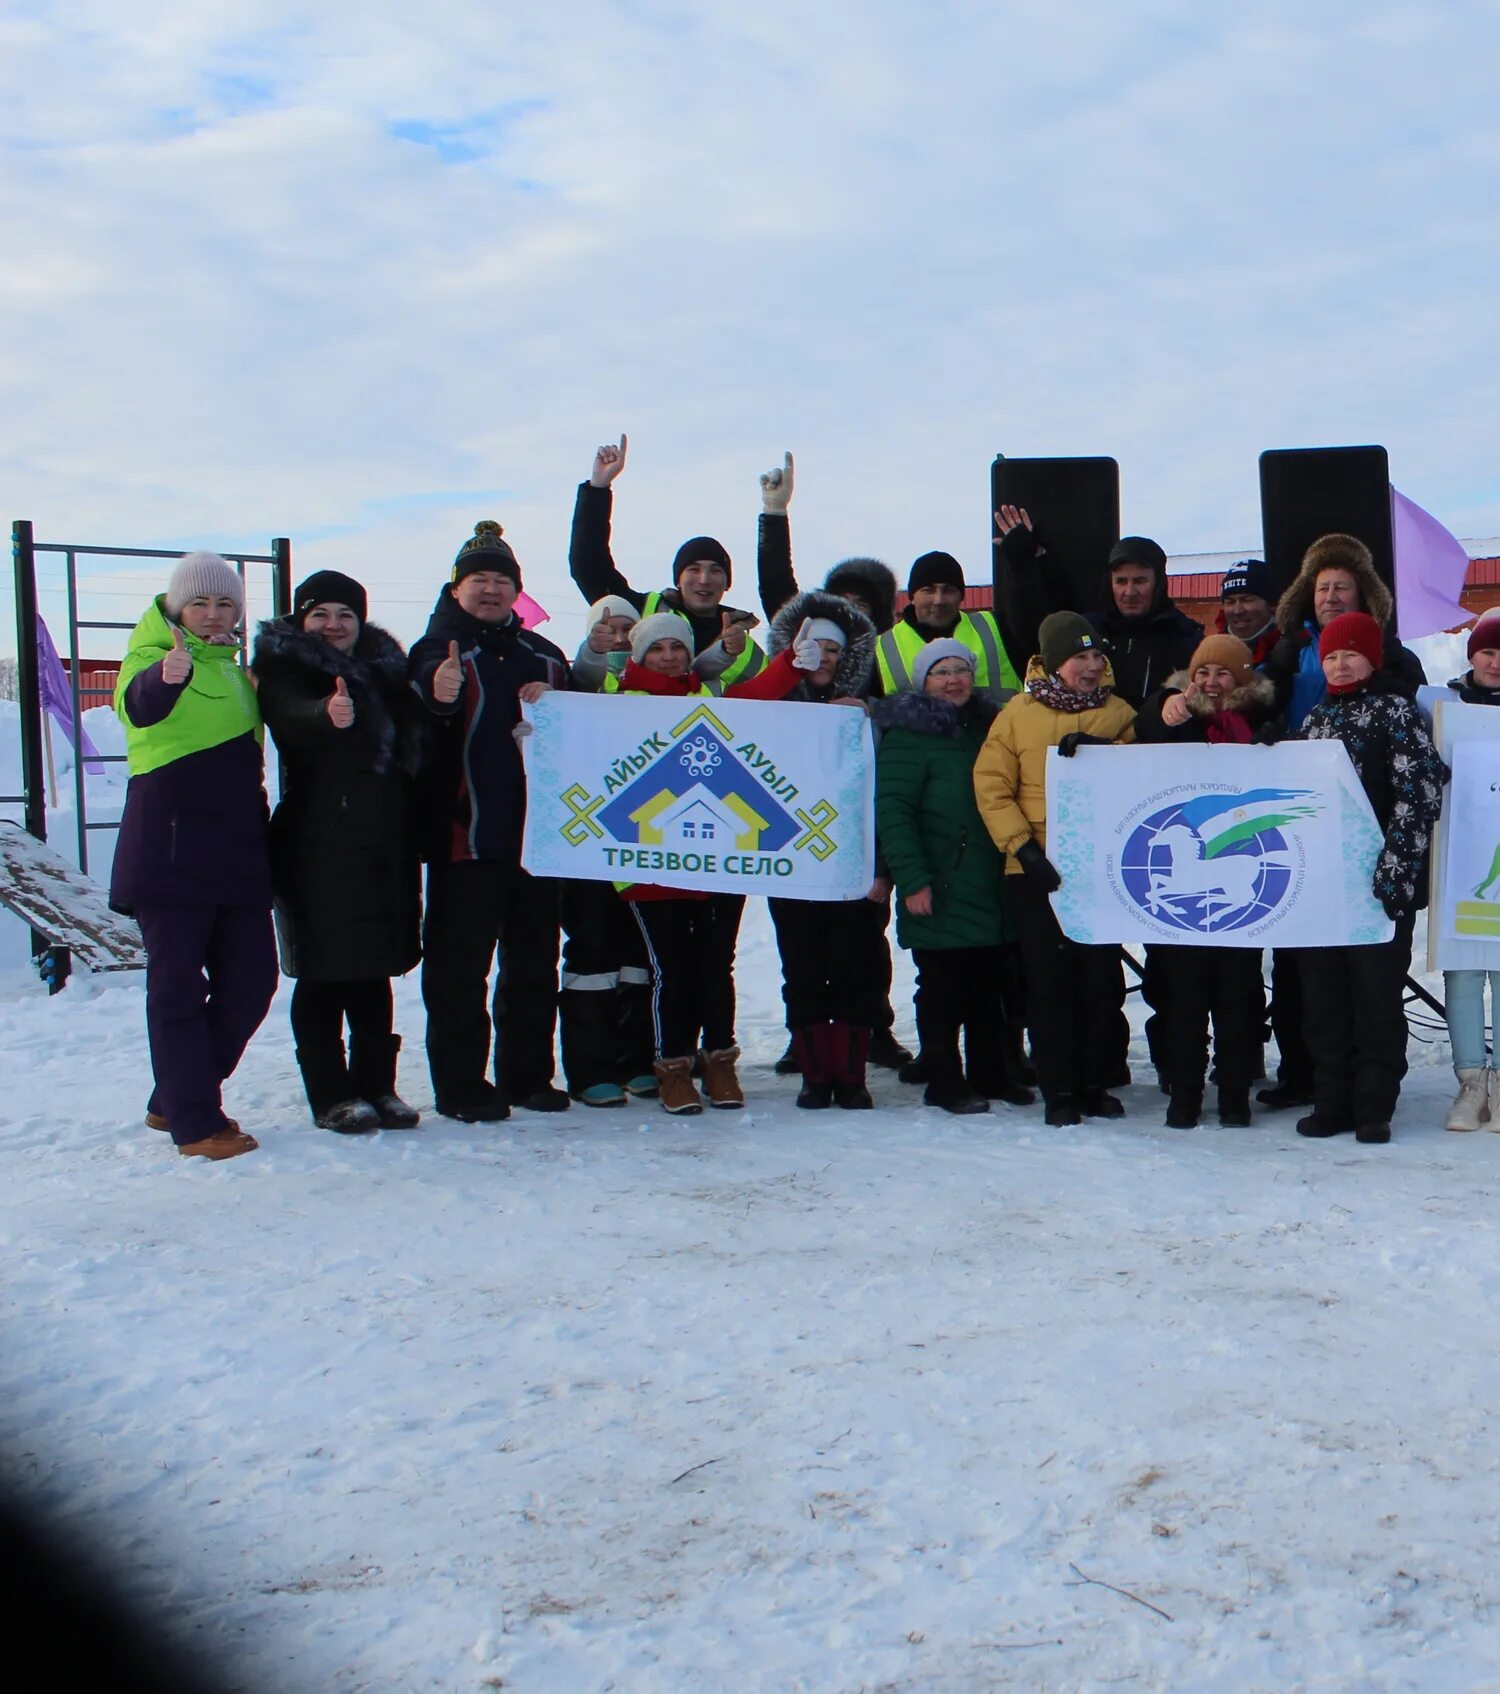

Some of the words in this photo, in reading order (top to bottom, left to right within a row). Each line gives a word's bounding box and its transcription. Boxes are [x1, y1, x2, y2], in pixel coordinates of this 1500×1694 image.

[602, 731, 669, 795] АЙЫҠ
[736, 742, 800, 803] АУЫЛ
[602, 847, 717, 873] ТРЕЗВОЕ
[723, 855, 794, 877] СЕЛО
[1105, 853, 1114, 879] WORLD
[1127, 905, 1148, 927] NATION
